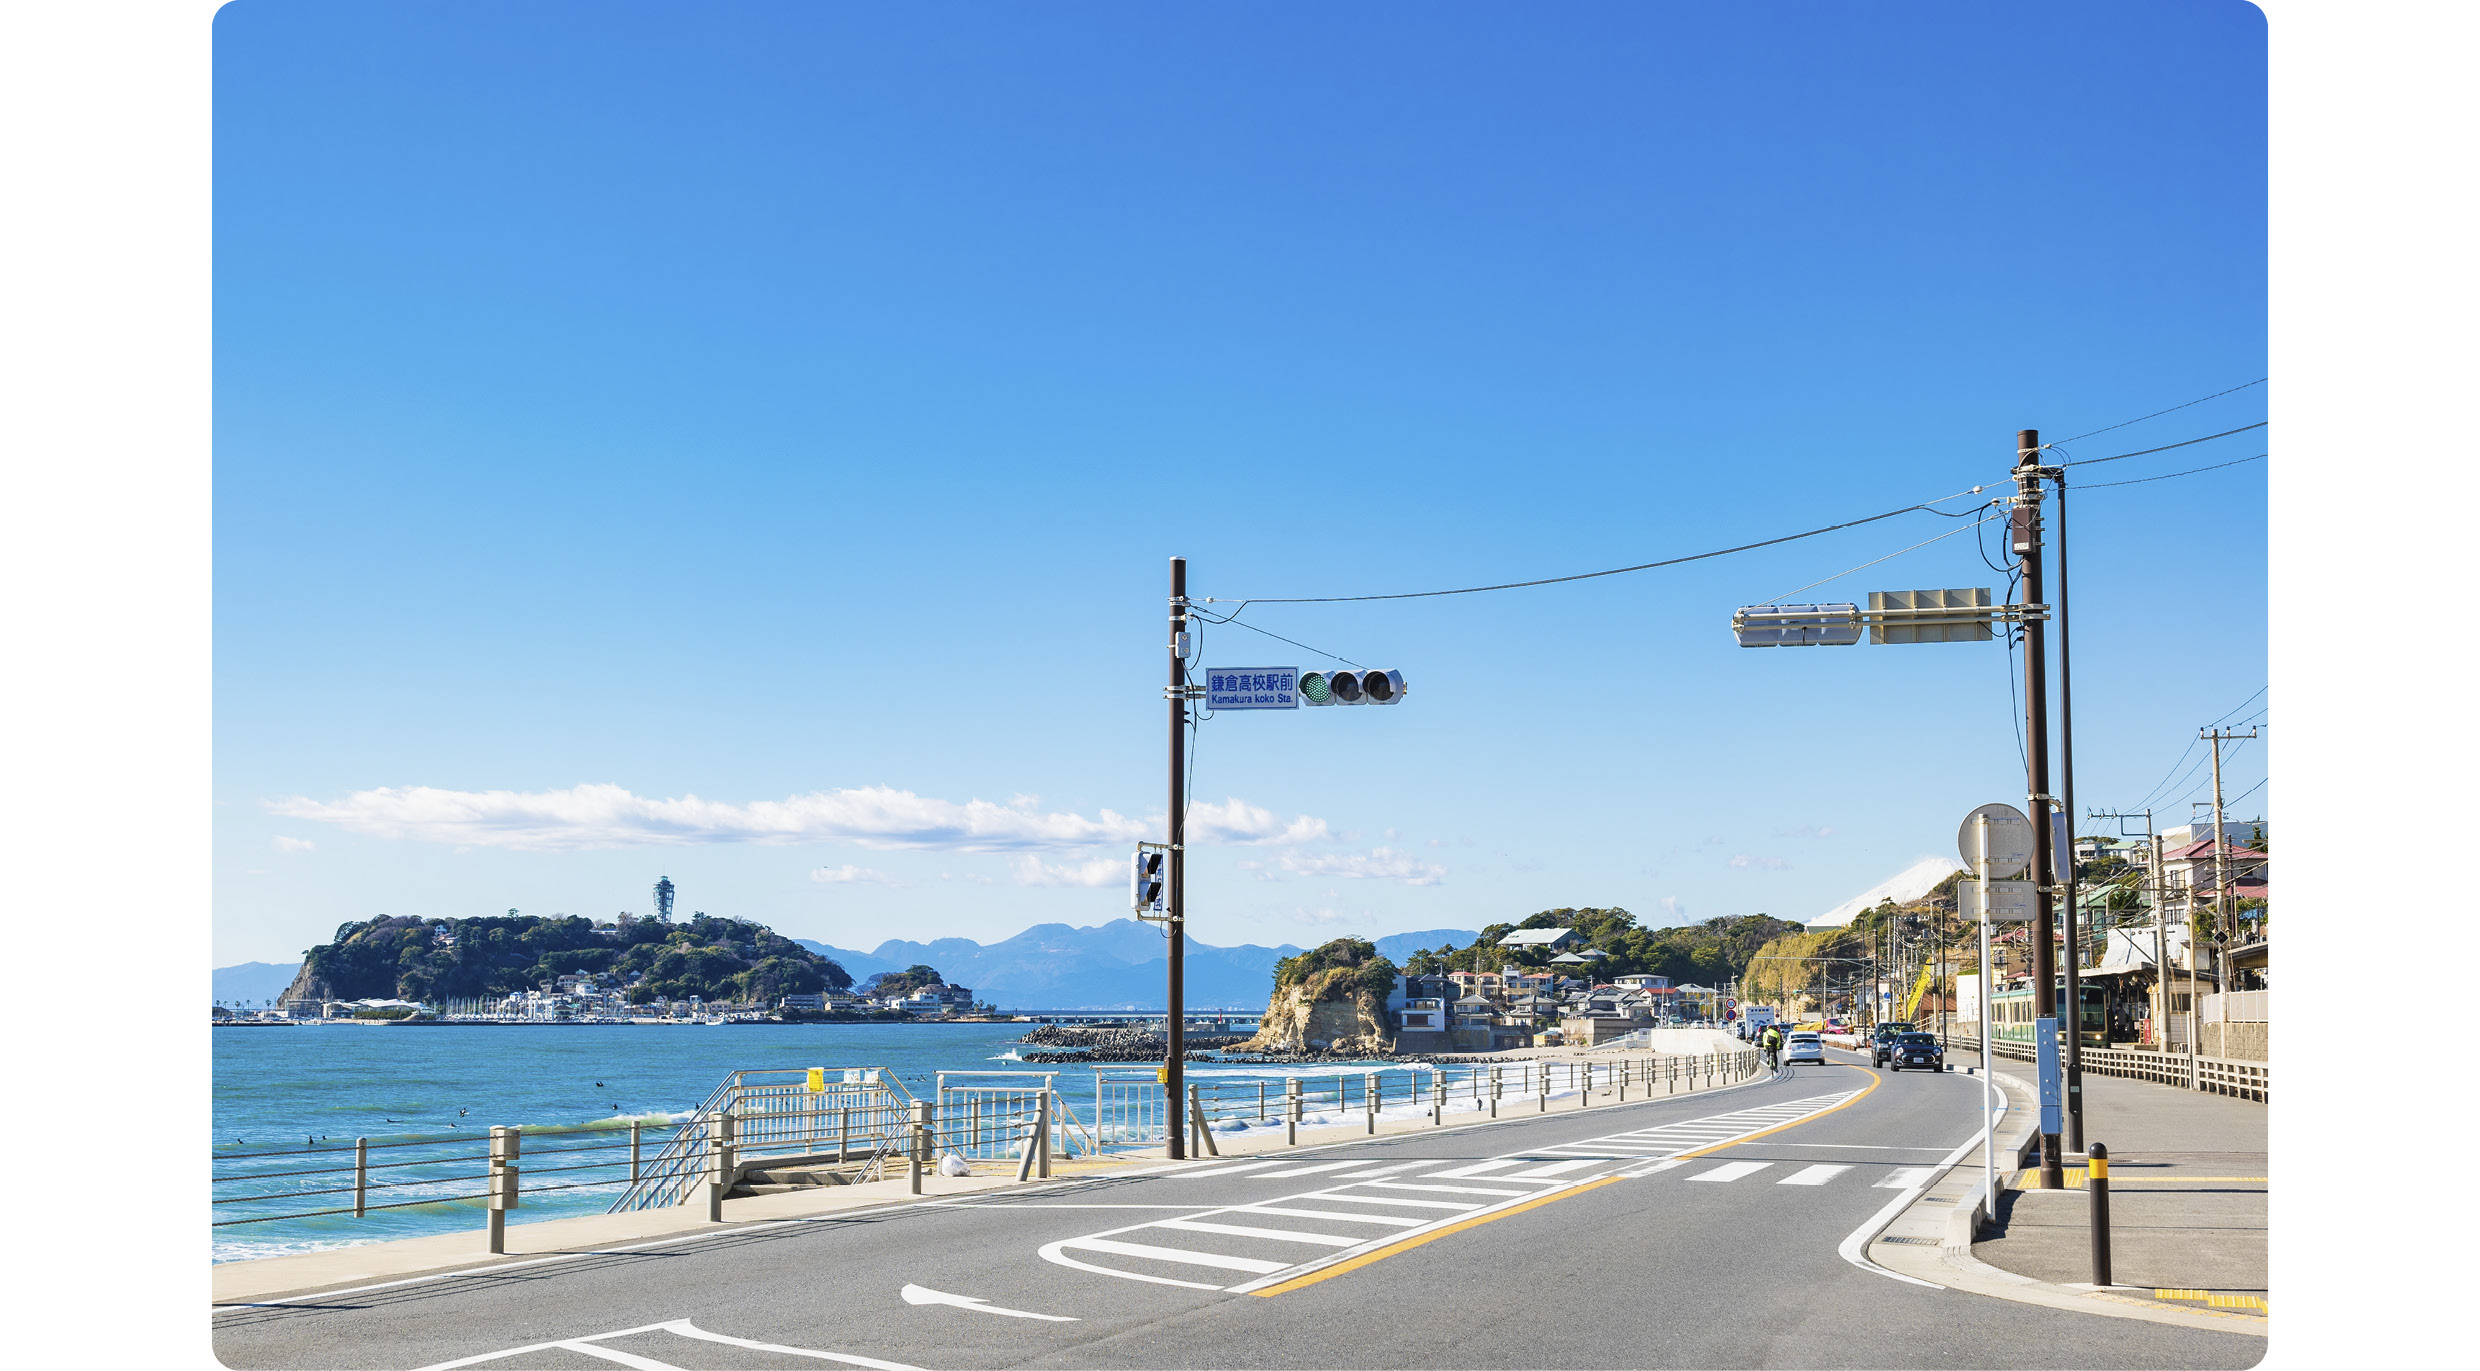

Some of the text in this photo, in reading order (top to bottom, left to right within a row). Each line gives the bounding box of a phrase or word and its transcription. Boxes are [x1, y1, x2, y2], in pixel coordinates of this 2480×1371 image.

[1211, 673, 1293, 692] 鎌倉高校駅前
[1211, 693, 1293, 703] Kamakura koko Sta.
